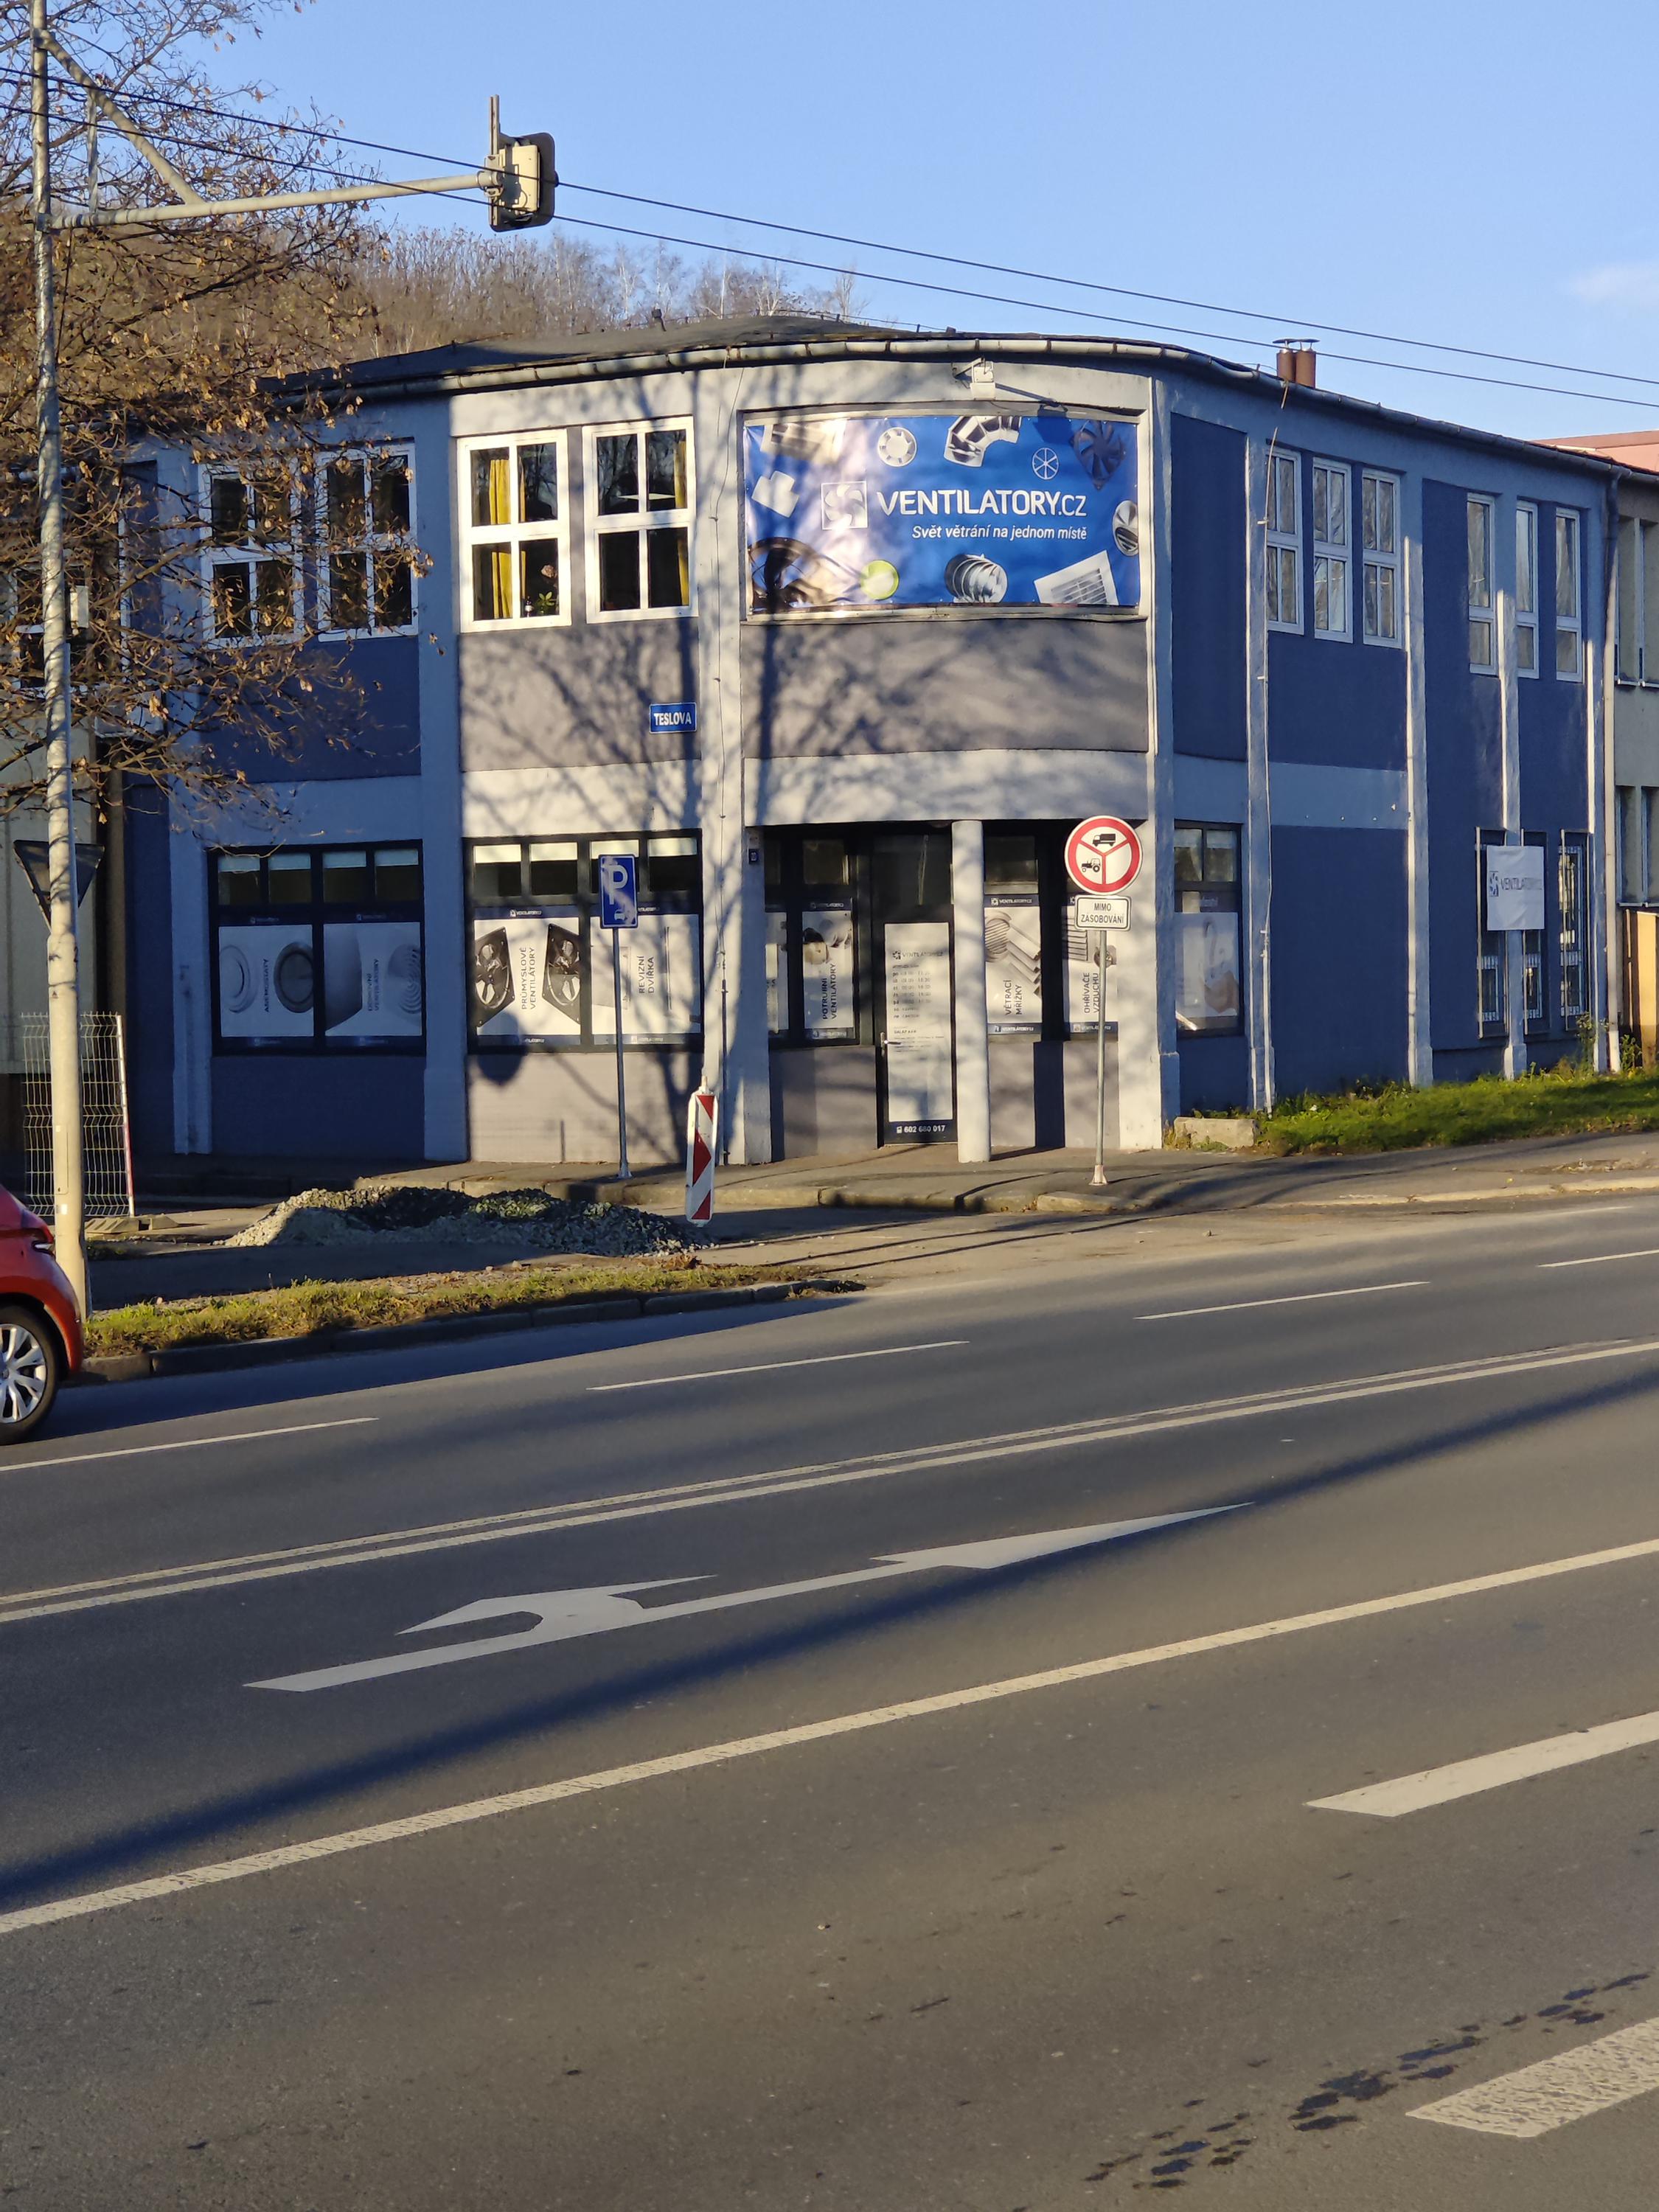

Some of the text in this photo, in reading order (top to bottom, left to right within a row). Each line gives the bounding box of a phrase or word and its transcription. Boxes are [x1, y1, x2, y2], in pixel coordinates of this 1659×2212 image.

[877, 490, 1087, 516] VENTILATORY.CZ
[912, 524, 1088, 541] Svět větrání na jednom místě
[653, 712, 692, 726] TESLOVA
[1093, 902, 1112, 912] MIMO
[519, 947, 528, 1010] PRŮMYSLOVÉ
[529, 947, 537, 1010] VENTILÁTORY
[637, 956, 645, 994] REVIZNÍ
[646, 956, 655, 994] DVÍŘKA
[1004, 979, 1012, 1015] VĚTRACÍ
[1014, 984, 1023, 1015] MŘÍŽKY
[1082, 972, 1091, 1014] OHŘÍVAČE
[904, 1125, 917, 1133] 602
[933, 1124, 946, 1133] 017
